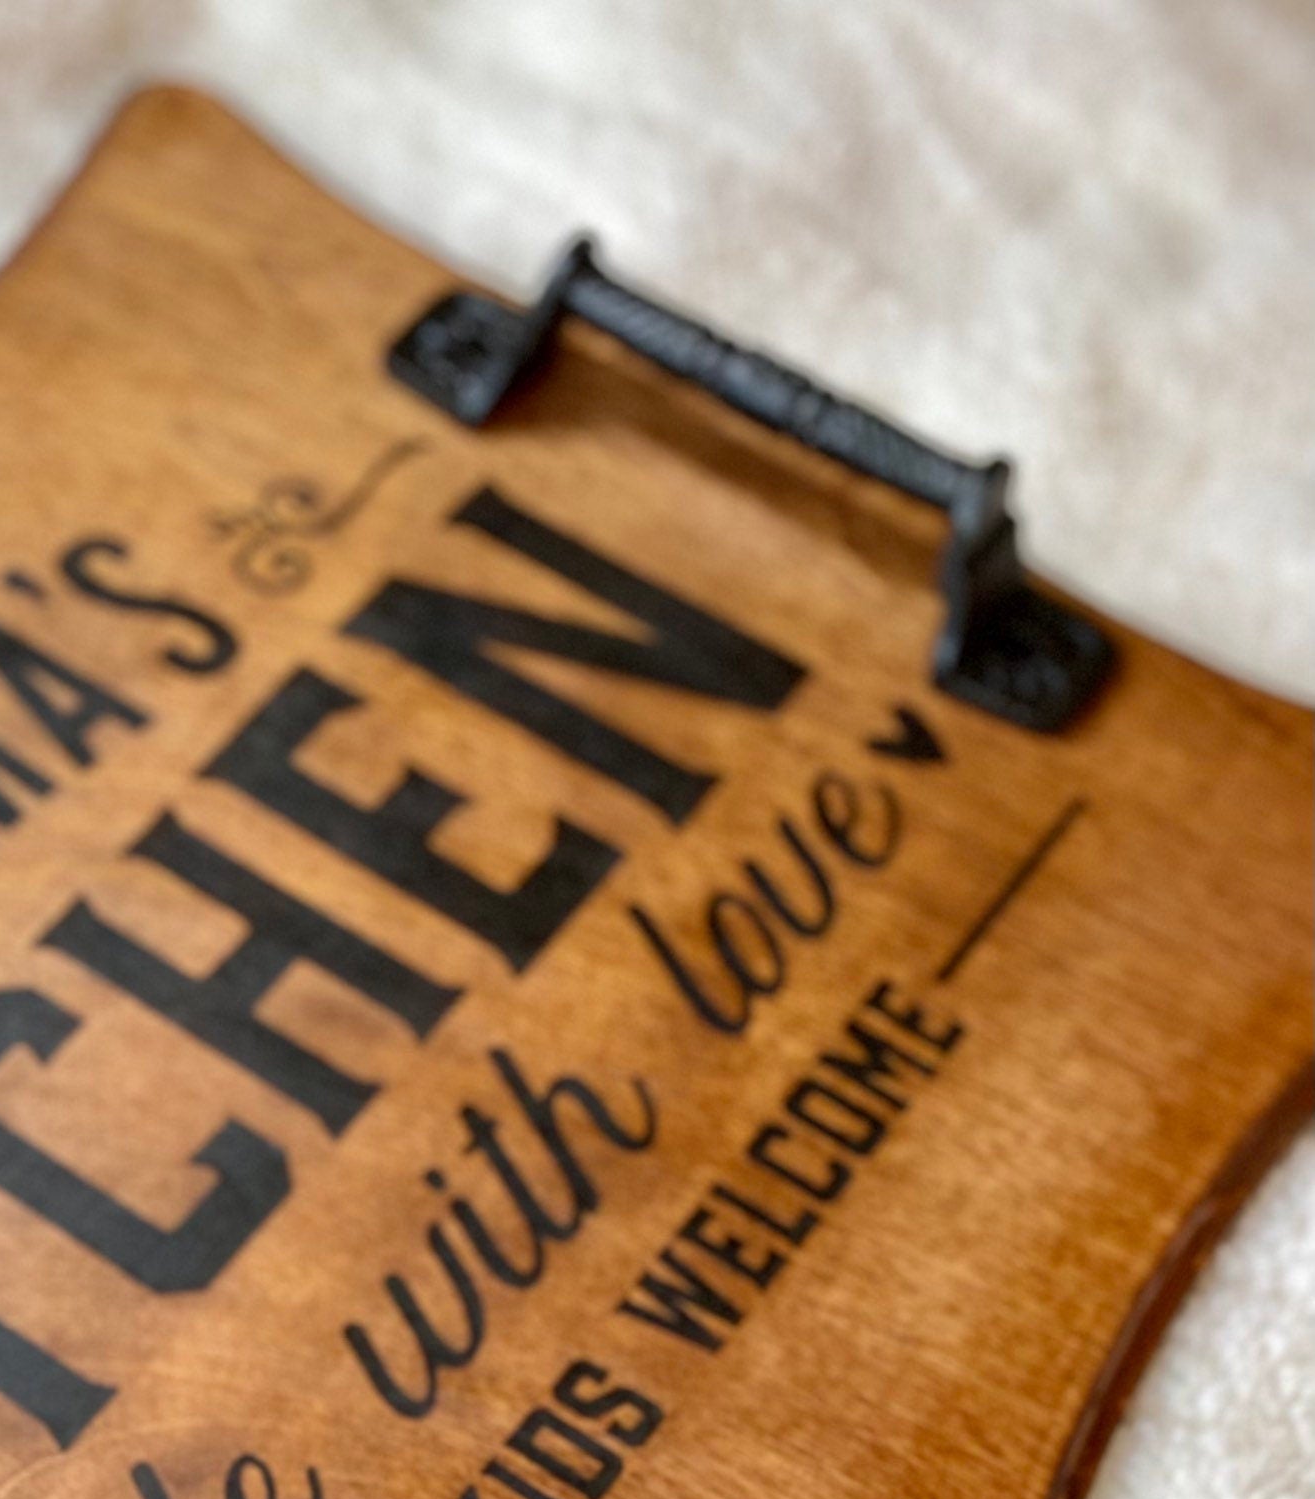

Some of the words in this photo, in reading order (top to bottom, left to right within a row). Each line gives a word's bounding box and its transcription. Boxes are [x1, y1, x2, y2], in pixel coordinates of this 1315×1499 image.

[343, 1049, 659, 1421] with
[626, 771, 907, 1041] love
[614, 978, 968, 1355] WELCOME
